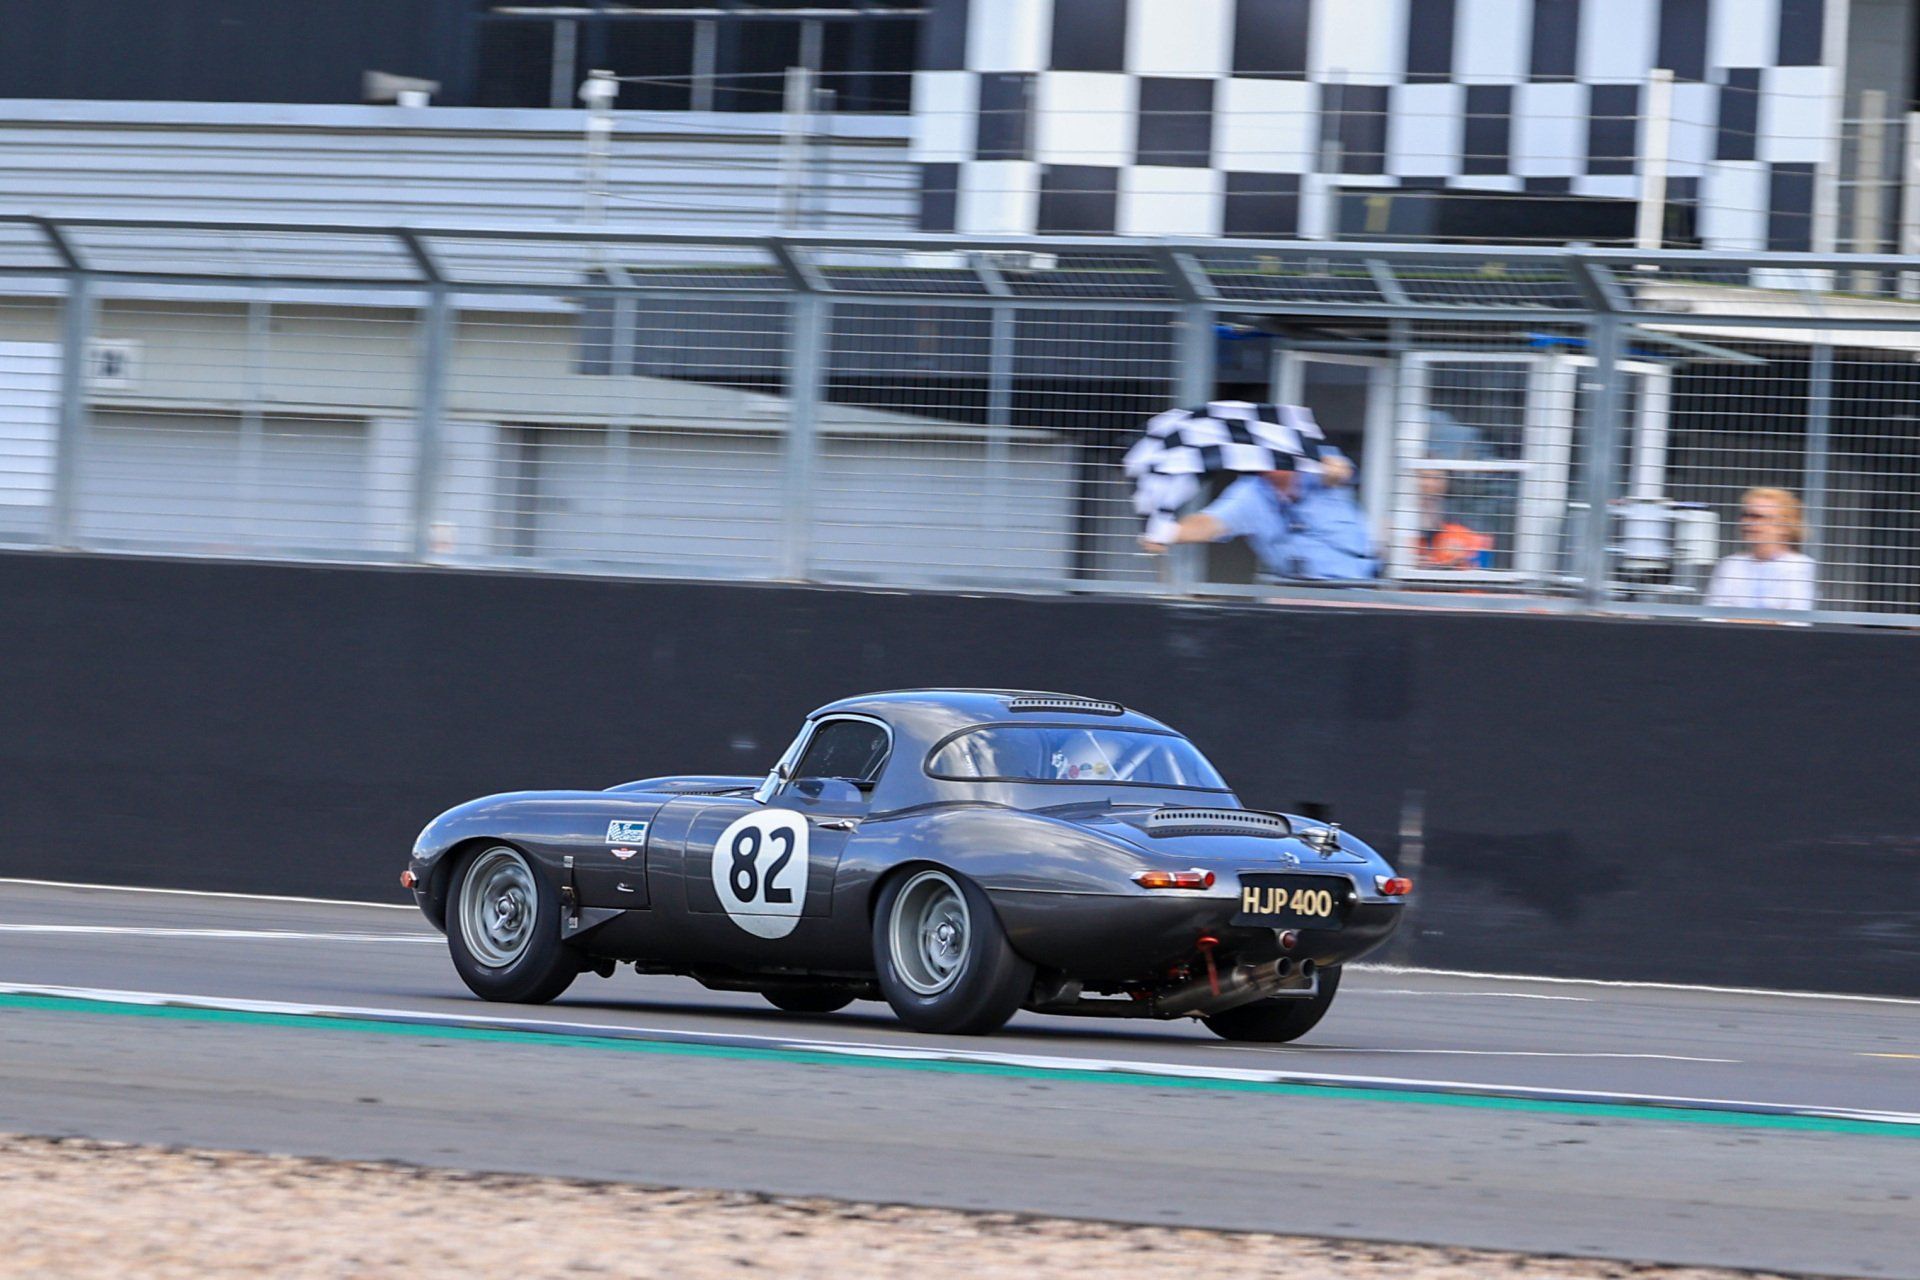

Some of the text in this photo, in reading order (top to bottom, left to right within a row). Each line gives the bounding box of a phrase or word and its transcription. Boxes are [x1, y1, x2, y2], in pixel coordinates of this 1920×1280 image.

[730, 826, 795, 903] 82
[1242, 886, 1332, 917] HJP 400
